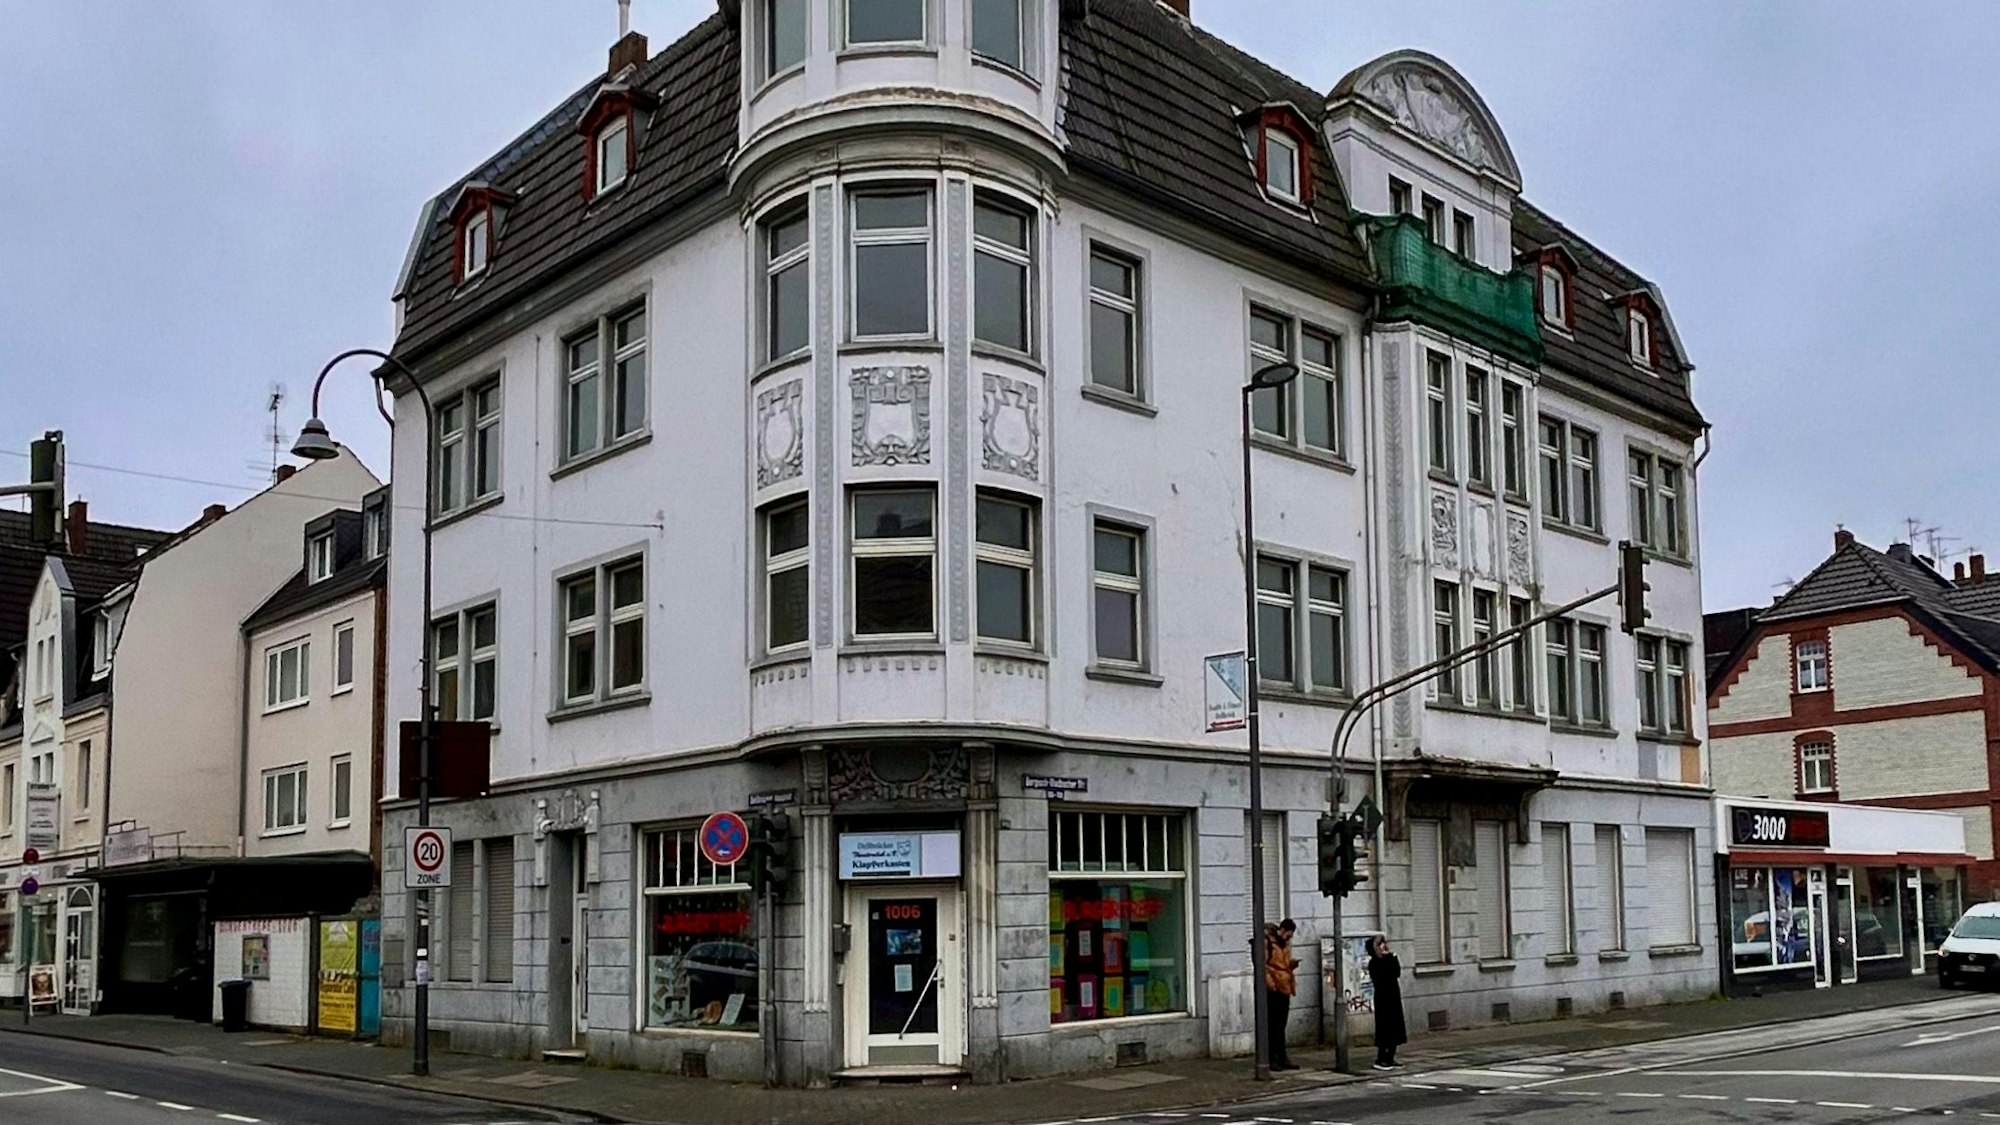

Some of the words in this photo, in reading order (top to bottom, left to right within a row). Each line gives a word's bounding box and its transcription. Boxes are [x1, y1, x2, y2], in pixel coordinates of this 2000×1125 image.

[1752, 814, 1786, 840] 3000
[421, 842, 438, 860] 20
[417, 873, 441, 884] ZONE
[884, 904, 922, 919] 1006
